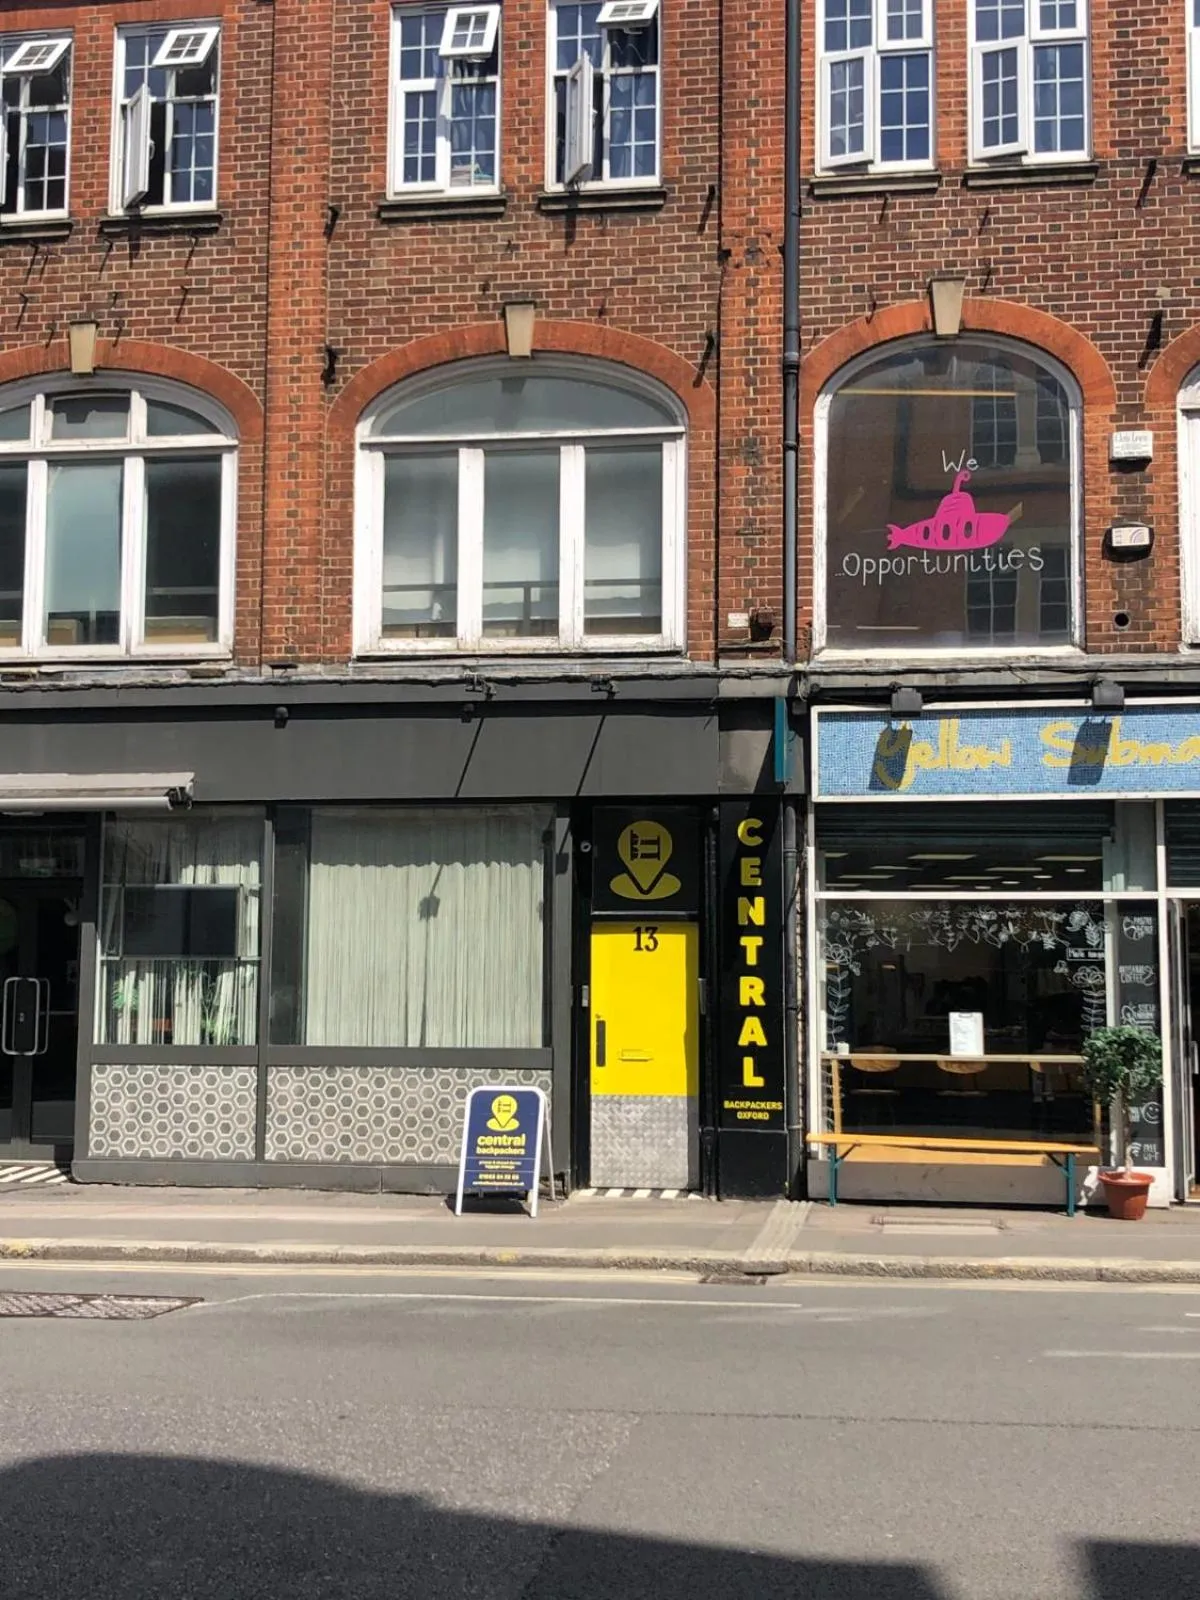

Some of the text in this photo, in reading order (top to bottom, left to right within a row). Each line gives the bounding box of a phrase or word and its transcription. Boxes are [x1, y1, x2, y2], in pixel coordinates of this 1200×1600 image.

[942, 449, 980, 472] We
[876, 717, 1013, 790] Yellow
[632, 926, 659, 952] 13
[737, 818, 769, 1087] CENTRAL
[723, 1100, 783, 1110] BACKPACKERS
[737, 1111, 769, 1120] OXFORD
[477, 1133, 526, 1146] central
[476, 1146, 526, 1156] backpackers
